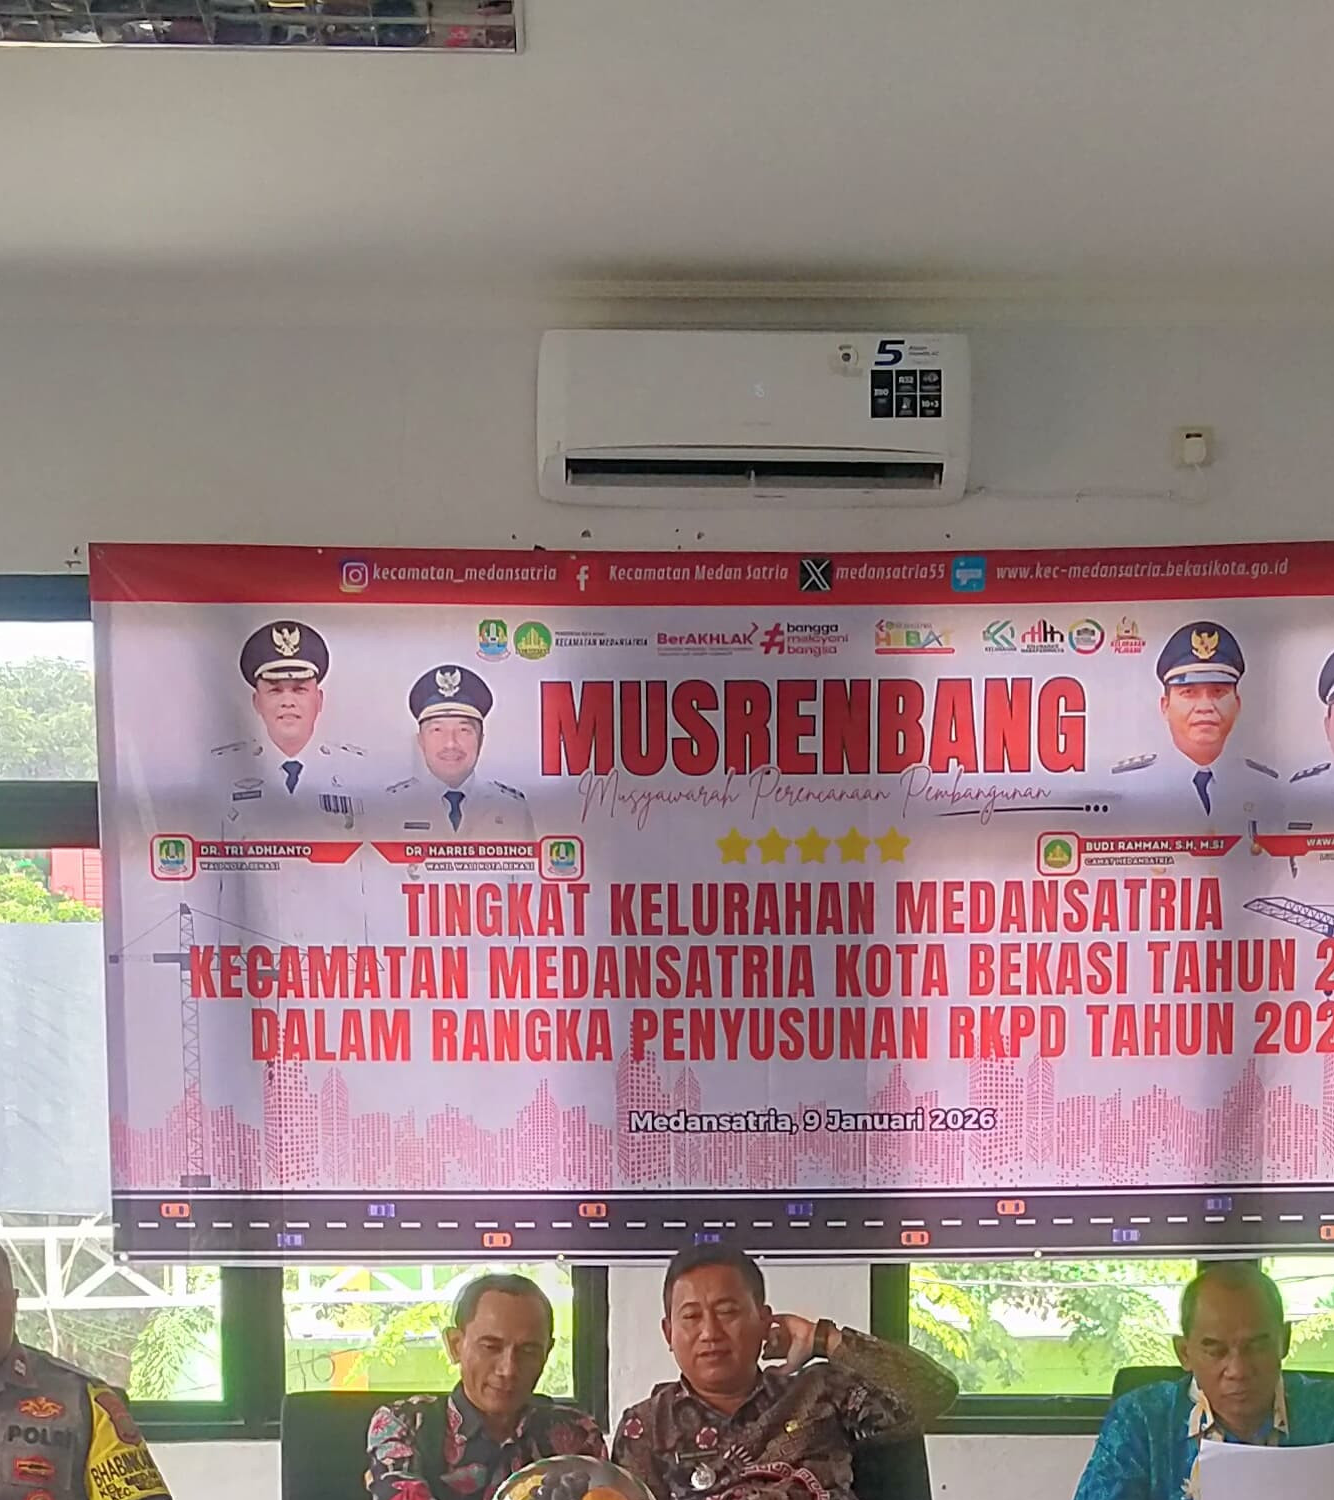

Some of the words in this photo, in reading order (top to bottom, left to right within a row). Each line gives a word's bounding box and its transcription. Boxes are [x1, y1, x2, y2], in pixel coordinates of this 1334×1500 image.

[874, 340, 905, 366] 5
[372, 563, 557, 583] kecamatan_medansatria
[609, 564, 690, 581] Kecamatan
[694, 564, 742, 581] Medan
[745, 564, 788, 580] Satria
[836, 563, 945, 580] medansatria55
[996, 557, 1289, 579] www.kec-medansatria.bekasikota.go.id
[657, 631, 754, 645] BerAKHLAK
[787, 621, 840, 635] bangga
[539, 678, 1086, 775] MUSRENBANG
[749, 766, 890, 819] Perencanaan
[900, 763, 1052, 825] Pembangunan
[224, 845, 244, 856] TRI
[247, 844, 312, 856] ADHIANTO
[428, 845, 475, 857] HARRIS
[1086, 840, 1115, 851] BUDI
[401, 883, 590, 937] TINGKAT
[610, 880, 874, 937] KELURAHAN
[896, 877, 1223, 934] MEDANSATRIA
[189, 944, 469, 999] KECAMATAN
[489, 943, 815, 999] MEDANSATRIA
[835, 942, 949, 997] KOTA
[968, 940, 1129, 996] BEKASI
[1146, 938, 1297, 994] TAHUN
[250, 1007, 418, 1061] DALAM
[432, 1007, 613, 1062] RANGKA
[633, 1004, 929, 1061] PENYUSUNAN
[948, 1003, 1068, 1059] RKPD
[1085, 1002, 1235, 1057] TAHUN
[629, 1107, 798, 1135] Medansatria,
[803, 1108, 821, 1131] 9
[826, 1107, 924, 1131] Januari
[929, 1107, 997, 1131] 2026
